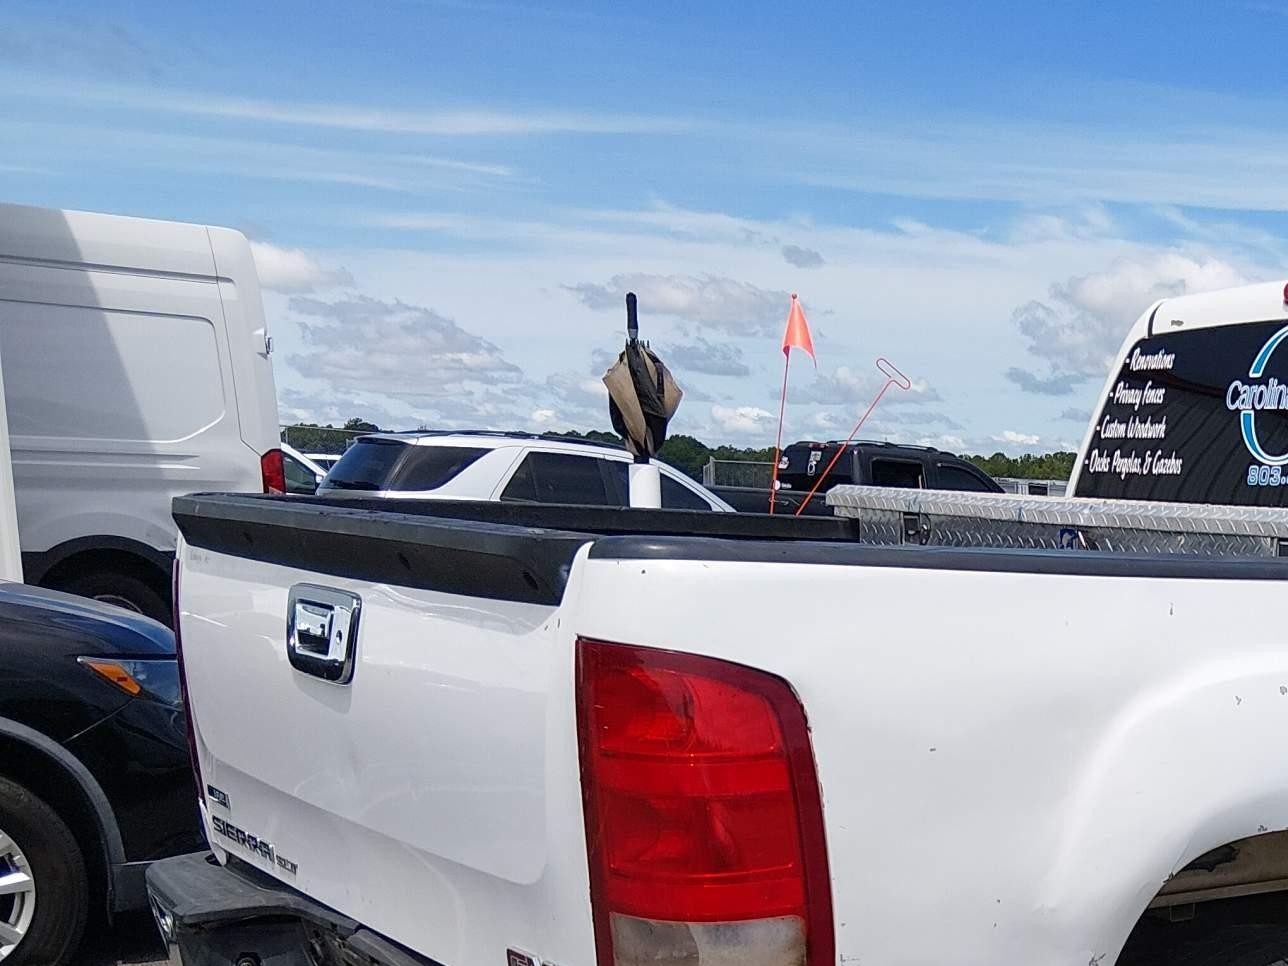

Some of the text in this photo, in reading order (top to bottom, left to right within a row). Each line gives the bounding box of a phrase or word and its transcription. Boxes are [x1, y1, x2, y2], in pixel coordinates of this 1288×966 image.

[1130, 347, 1175, 371] Renovations
[1113, 381, 1142, 411] Privacy
[1101, 414, 1126, 439] Custom
[1127, 415, 1167, 439] Woodwork
[1089, 449, 1110, 473] Decks
[1111, 449, 1141, 480] Pergolas,
[1143, 450, 1152, 475] &
[1152, 449, 1182, 475] Gazebos
[212, 815, 276, 864] SIERRA
